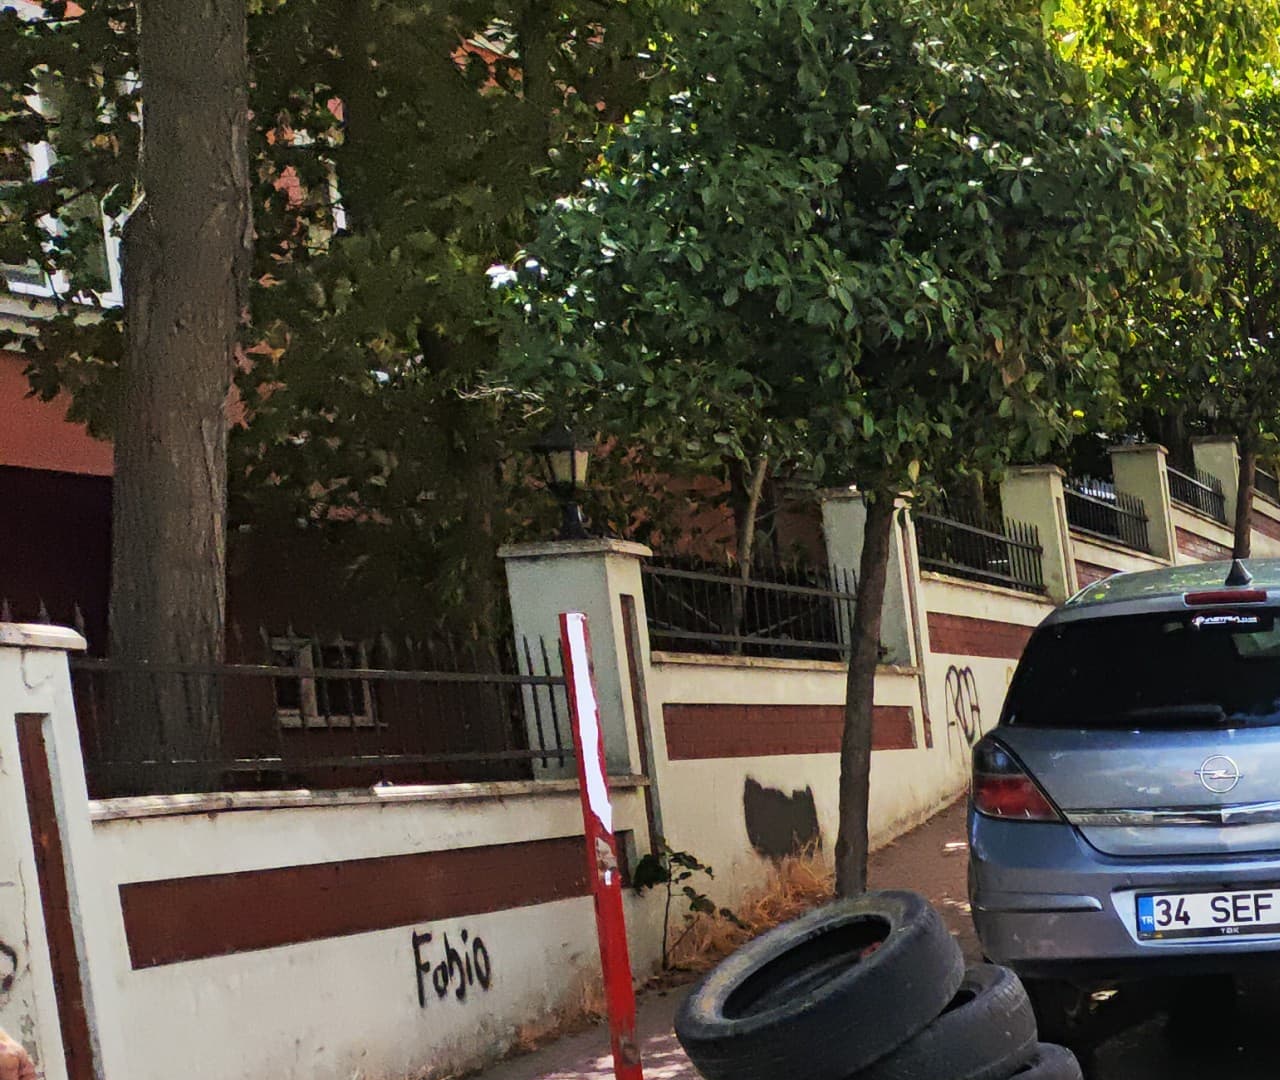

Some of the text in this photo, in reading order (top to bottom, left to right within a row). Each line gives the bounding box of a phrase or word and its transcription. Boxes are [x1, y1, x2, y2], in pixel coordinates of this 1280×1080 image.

[1156, 898, 1190, 926] 34
[1210, 893, 1273, 923] SEF
[1142, 916, 1153, 925] TR
